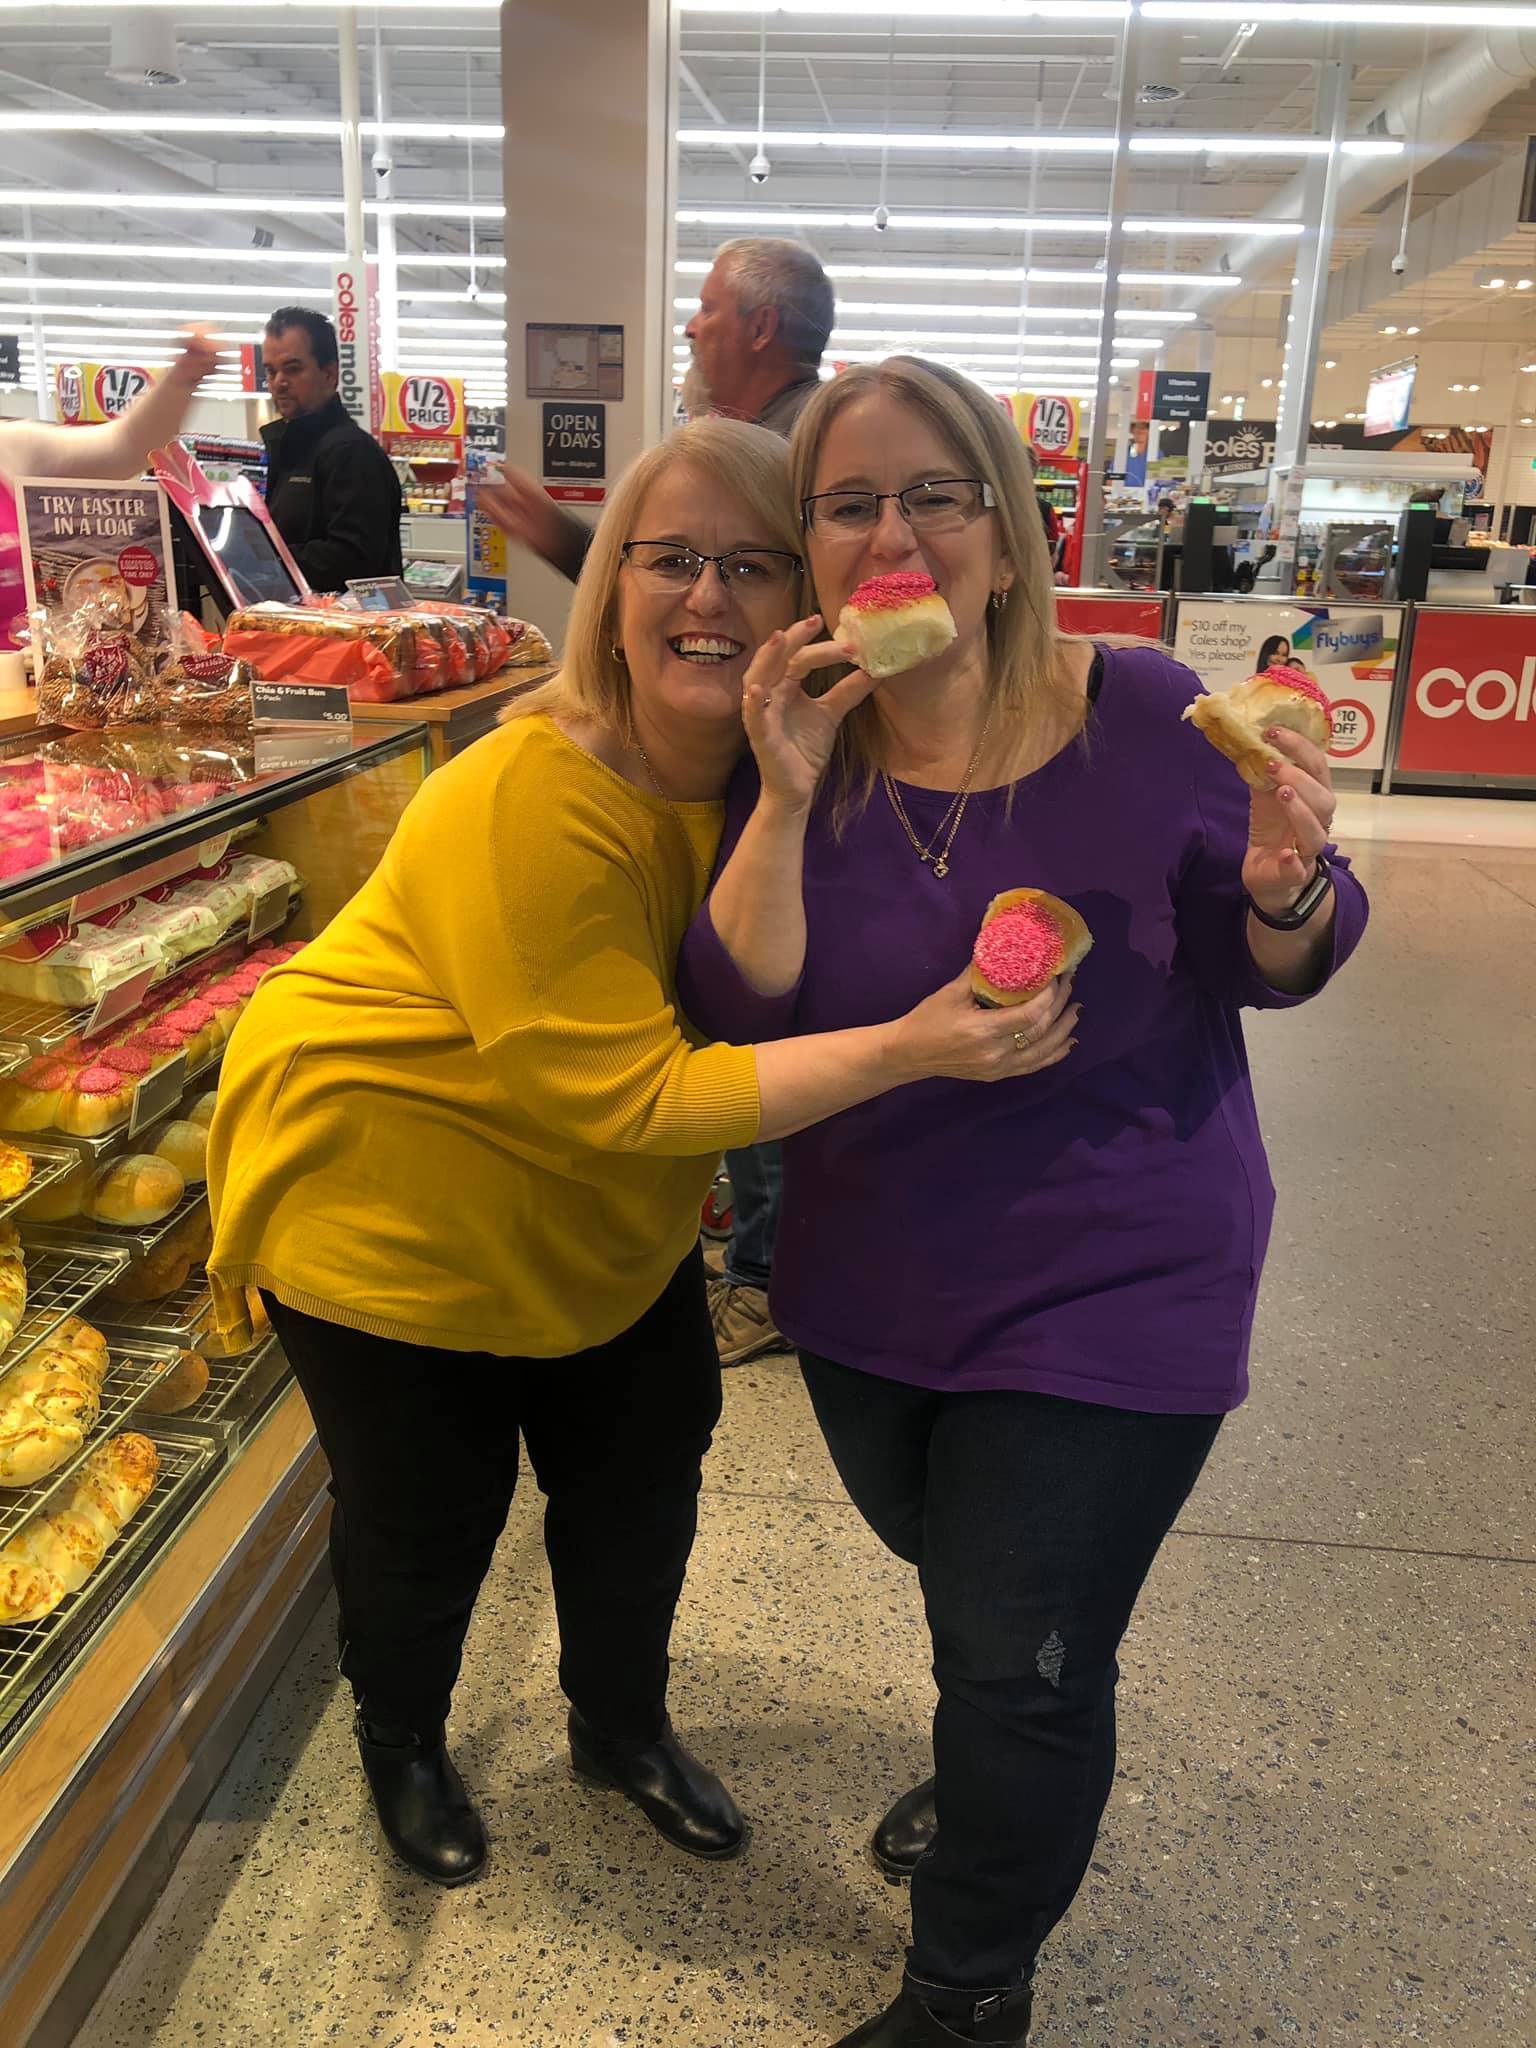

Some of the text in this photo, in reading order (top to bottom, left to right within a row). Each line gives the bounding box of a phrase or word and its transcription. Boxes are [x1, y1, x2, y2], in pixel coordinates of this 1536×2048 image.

[337, 272, 365, 417] colesmobil
[409, 379, 446, 408] 1/2
[408, 408, 449, 423] PRICE
[466, 409, 498, 425] AST
[1038, 398, 1066, 428] 1/2
[551, 414, 597, 431] OPEN
[546, 432, 602, 449] 7 DAYS
[1034, 427, 1069, 444] PRICE
[1203, 436, 1259, 459] coles
[39, 496, 147, 517] TRY EASTER
[53, 517, 137, 537] IN A LOAF
[1212, 620, 1228, 632] off
[1229, 623, 1247, 635] my
[1190, 634, 1252, 649] Coles shop?
[1316, 631, 1379, 652] flybuys
[1189, 648, 1206, 660] Yes
[255, 686, 326, 697] Chia & Fruit Bun
[1415, 655, 1536, 721] col
[322, 711, 349, 721] $5.00
[1333, 722, 1358, 734] OFF
[0, 1716, 22, 1746] erage
[22, 1691, 41, 1719] adult
[42, 1667, 58, 1693] daily
[58, 1642, 81, 1671] energy
[80, 1614, 101, 1642] intake
